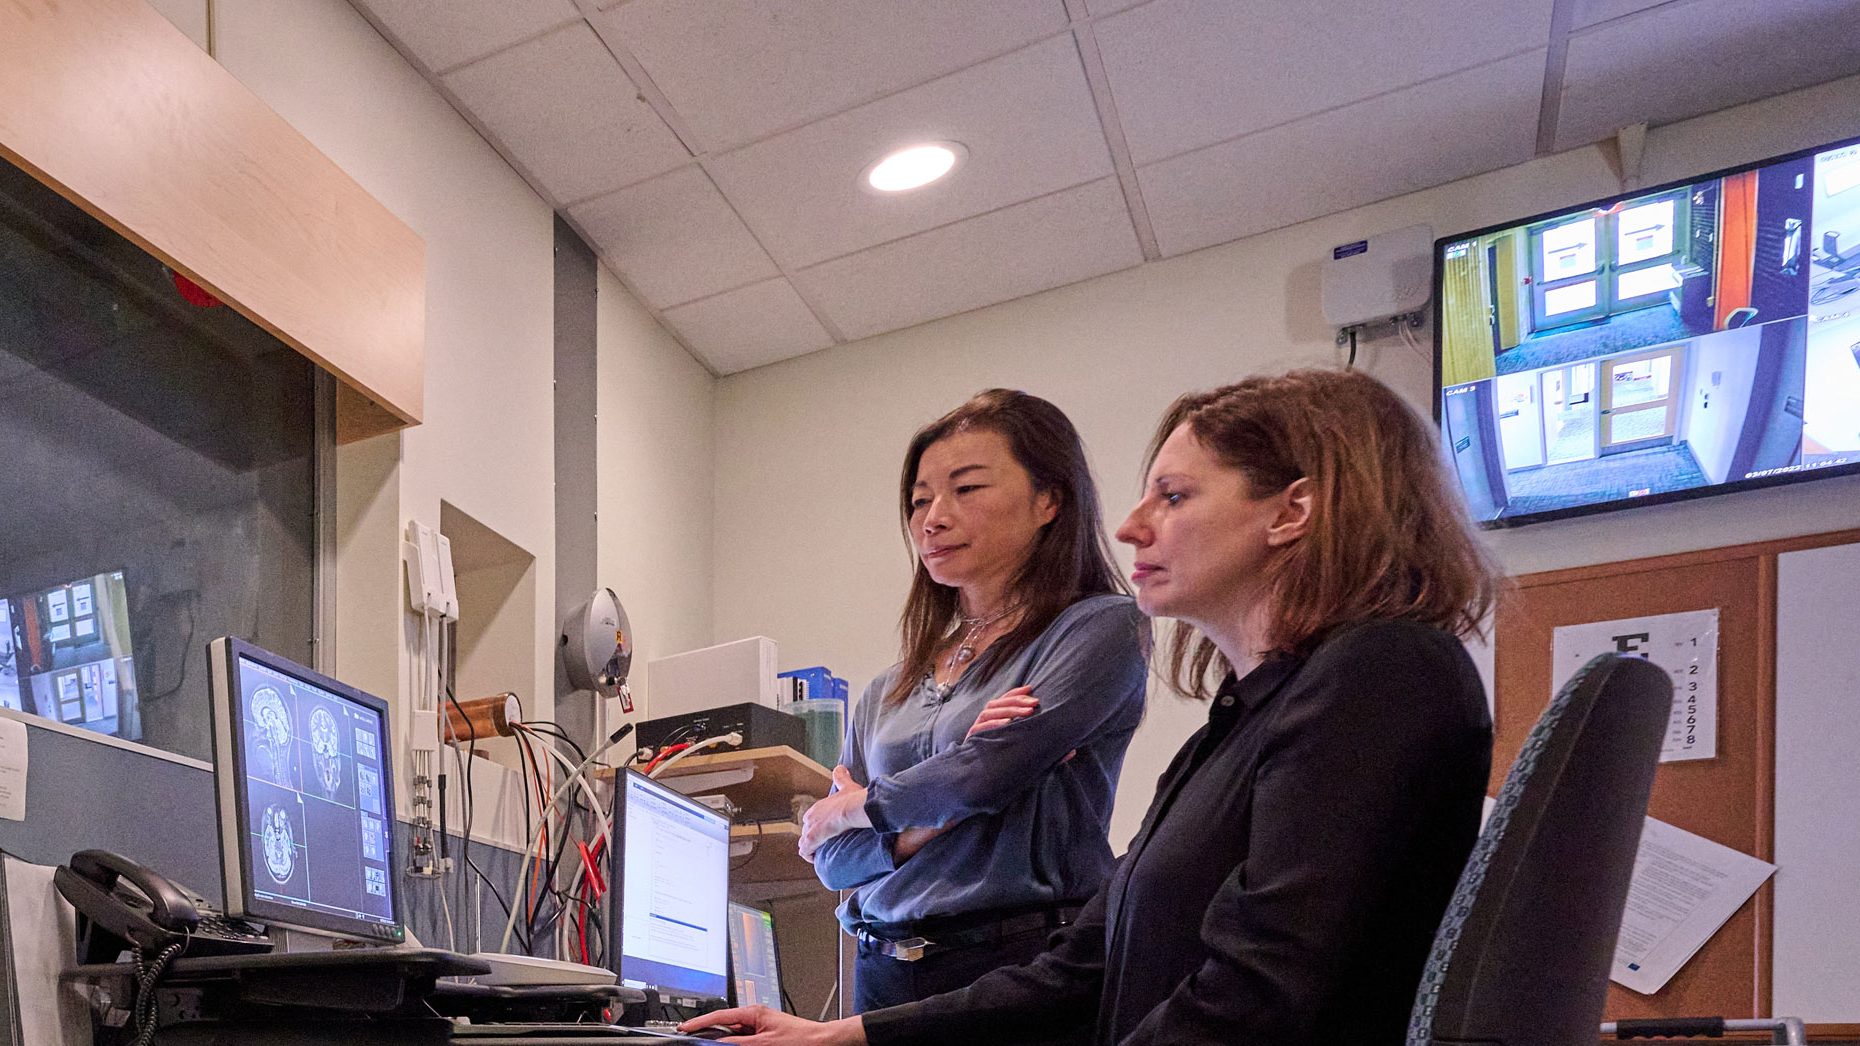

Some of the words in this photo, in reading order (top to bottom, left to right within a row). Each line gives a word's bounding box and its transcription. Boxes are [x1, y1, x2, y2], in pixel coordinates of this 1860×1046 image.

[1445, 387, 1467, 396] CAM
[1689, 665, 1698, 675] 2
[1688, 682, 1697, 691] 3
[1687, 695, 1696, 704] 4
[1687, 705, 1696, 714] 5
[1686, 715, 1696, 724] 6
[1686, 725, 1696, 734] 7
[1686, 735, 1695, 744] 8
